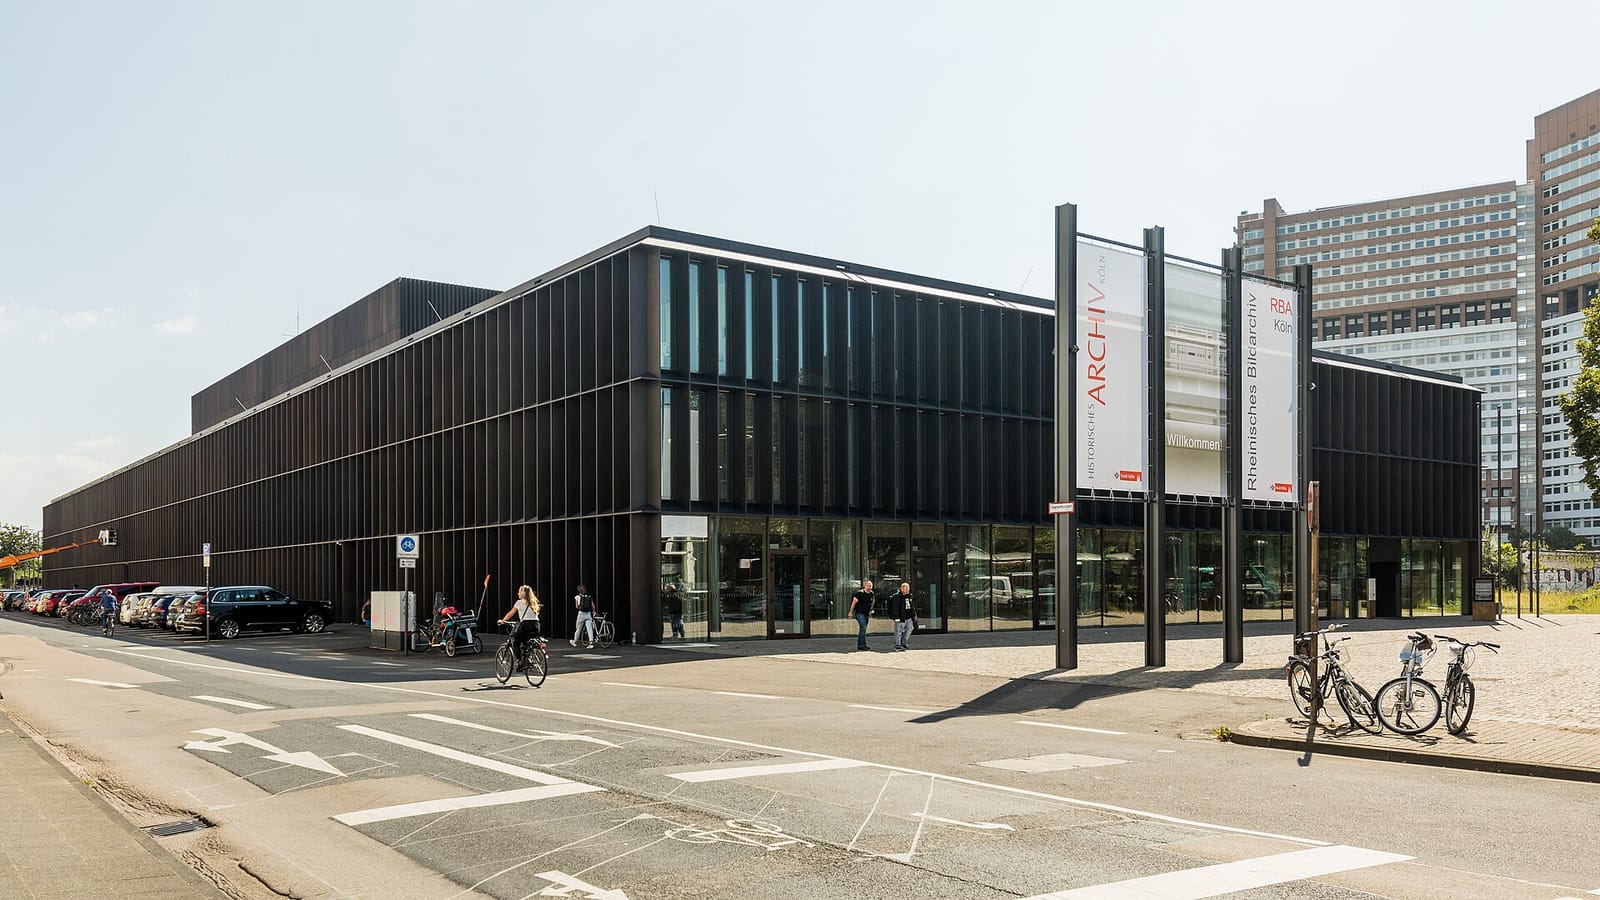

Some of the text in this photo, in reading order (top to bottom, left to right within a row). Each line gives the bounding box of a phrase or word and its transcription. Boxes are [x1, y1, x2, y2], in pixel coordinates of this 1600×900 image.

[1270, 297, 1293, 316] RBA
[1273, 319, 1293, 334] Köln
[1087, 255, 1106, 479] HISTORISCHES ARCHIV KÖLN
[1246, 293, 1257, 491] Rheinisches Bildarchiv
[1166, 433, 1223, 451] Willkommen!
